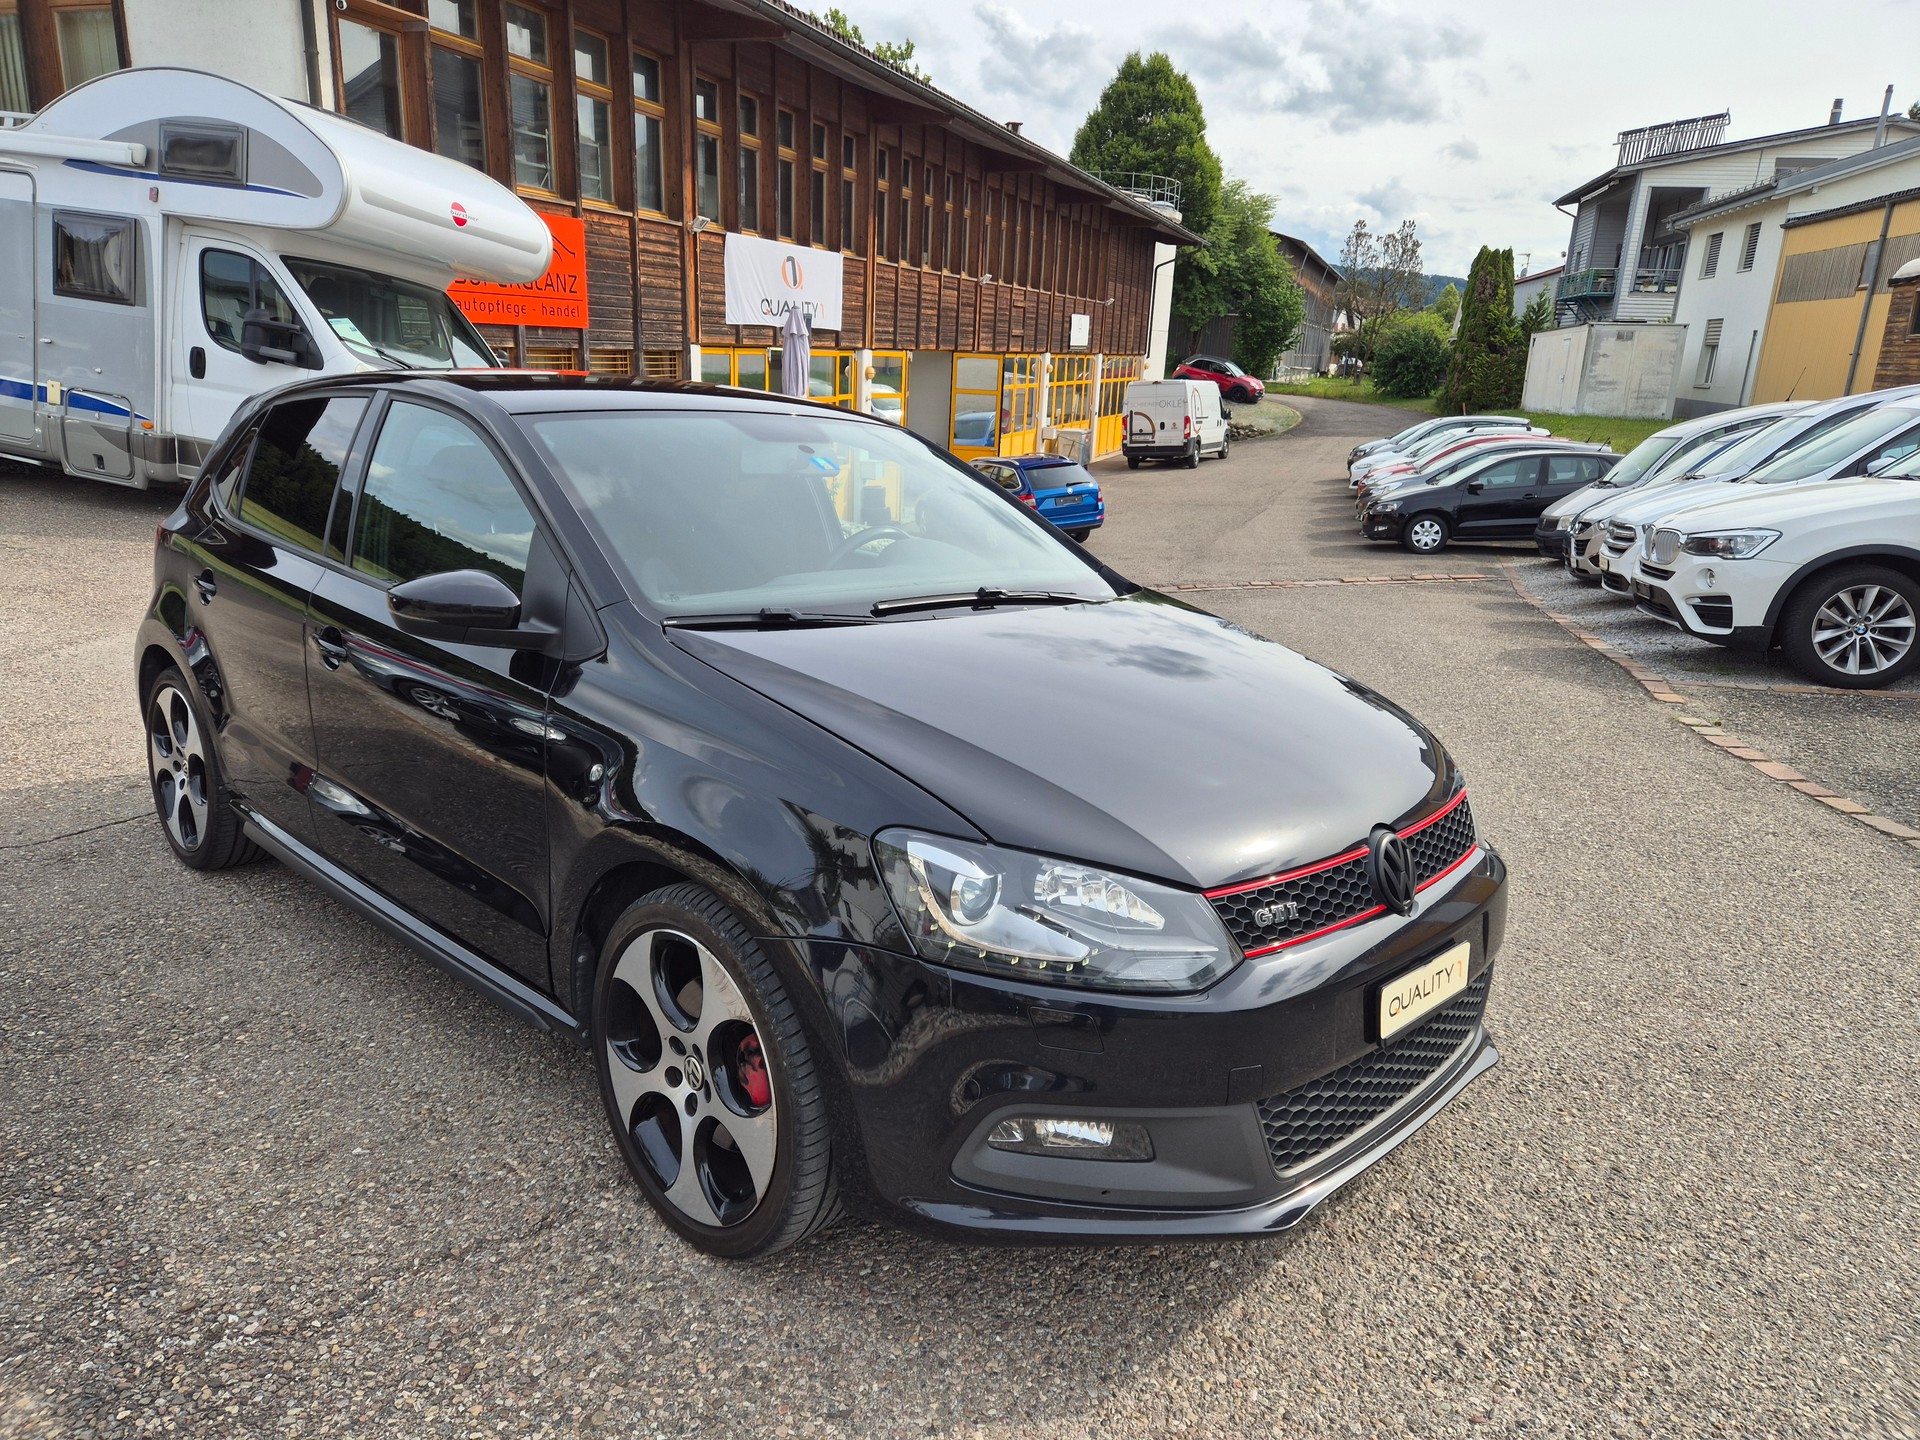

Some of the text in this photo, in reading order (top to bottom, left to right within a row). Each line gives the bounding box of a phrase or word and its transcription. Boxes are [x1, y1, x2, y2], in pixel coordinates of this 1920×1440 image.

[455, 297, 527, 317] autopflege
[541, 302, 580, 318] handel
[1254, 901, 1299, 928] GTI
